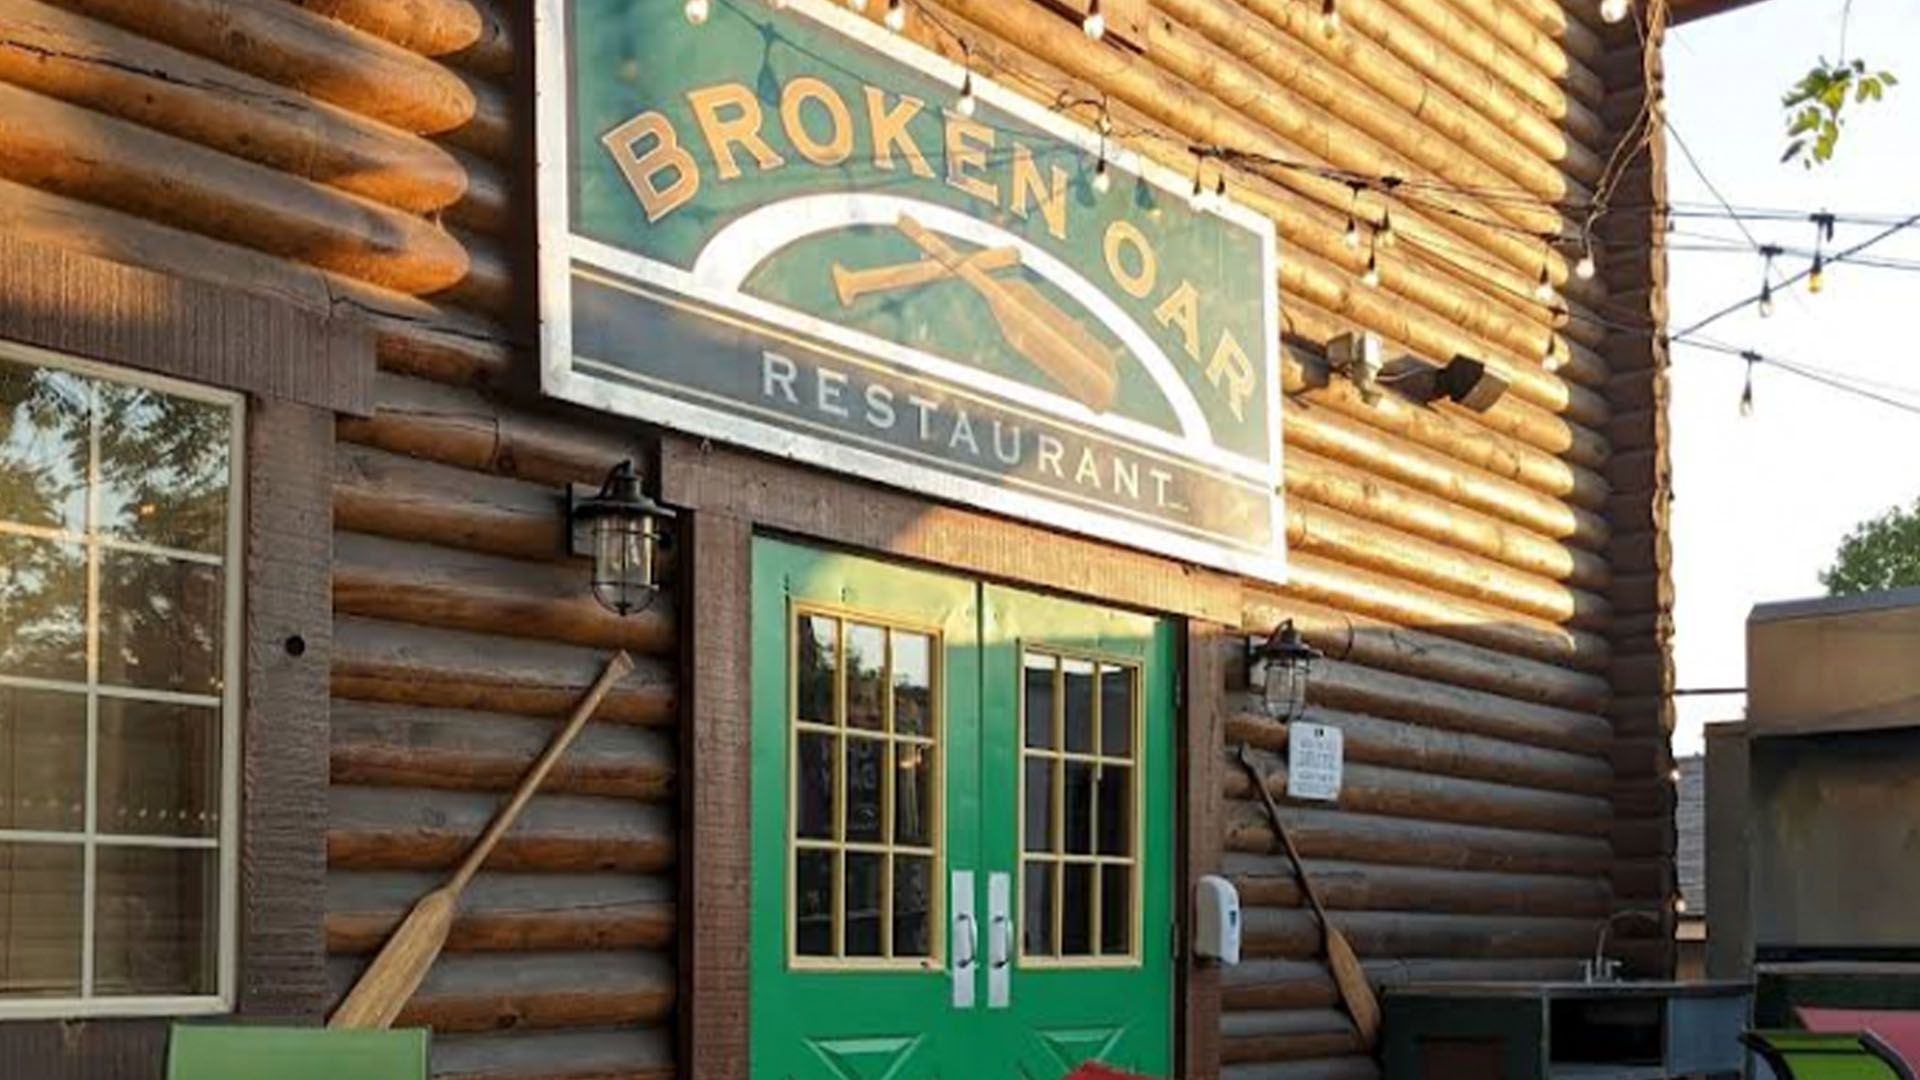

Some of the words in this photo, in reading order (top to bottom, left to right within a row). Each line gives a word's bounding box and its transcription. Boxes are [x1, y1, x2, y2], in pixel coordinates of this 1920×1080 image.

[602, 77, 1068, 240] BROKEN
[1103, 220, 1257, 422] OAR
[762, 352, 1173, 507] RESTAURANT
